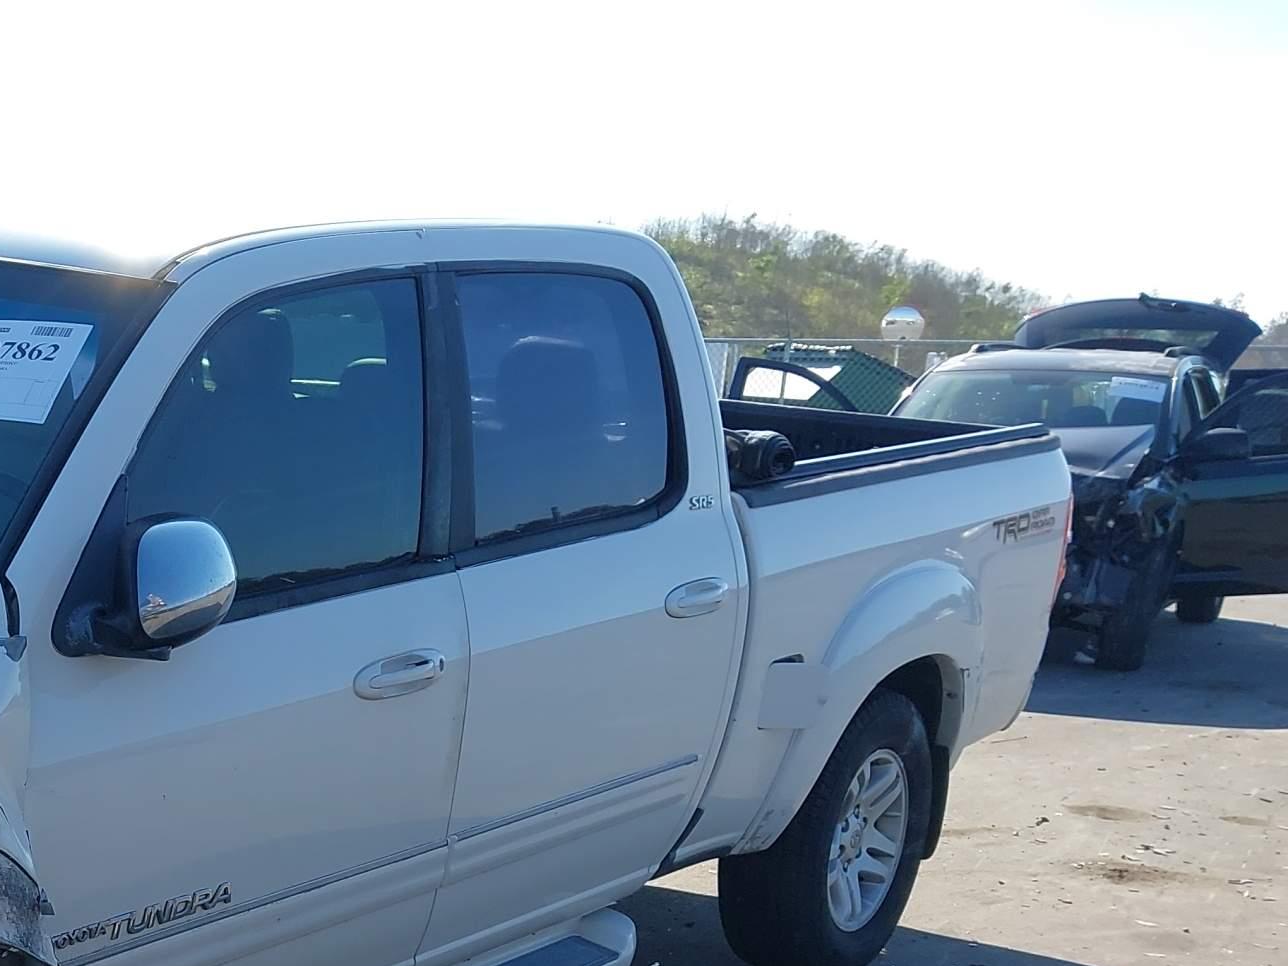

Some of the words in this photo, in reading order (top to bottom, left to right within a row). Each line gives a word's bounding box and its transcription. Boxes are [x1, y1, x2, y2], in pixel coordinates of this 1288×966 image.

[689, 495, 714, 510] SR5
[993, 512, 1031, 545] TRD
[105, 881, 232, 940] TUNDRA
